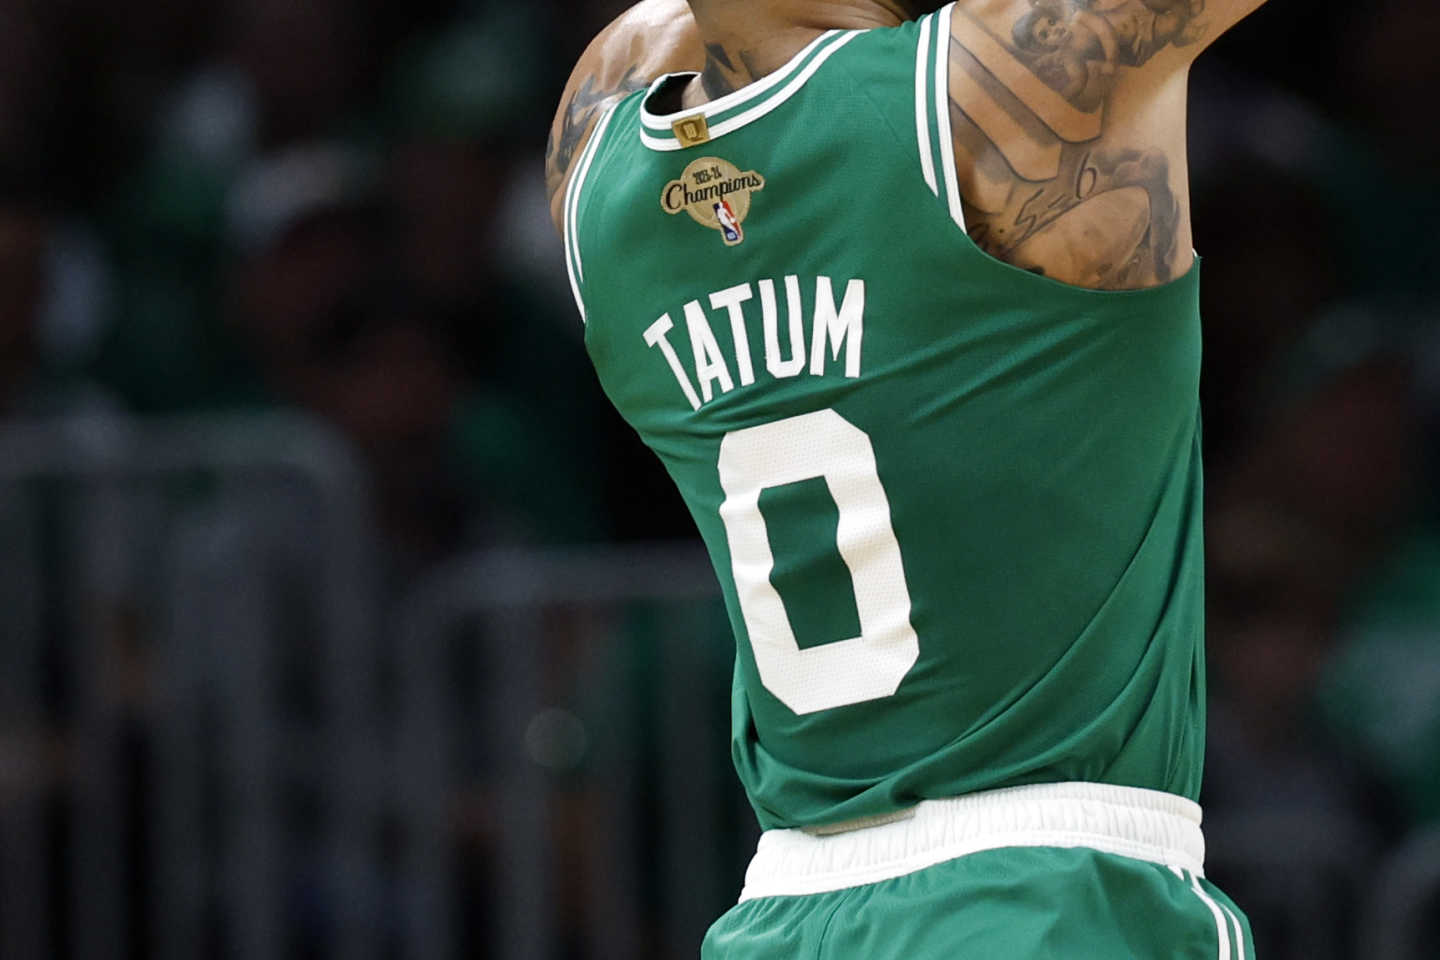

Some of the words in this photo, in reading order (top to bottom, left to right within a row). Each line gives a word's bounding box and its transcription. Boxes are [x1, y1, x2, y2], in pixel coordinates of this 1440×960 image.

[665, 174, 761, 210] Champions
[643, 274, 866, 412] TATUM
[717, 407, 921, 716] 0
